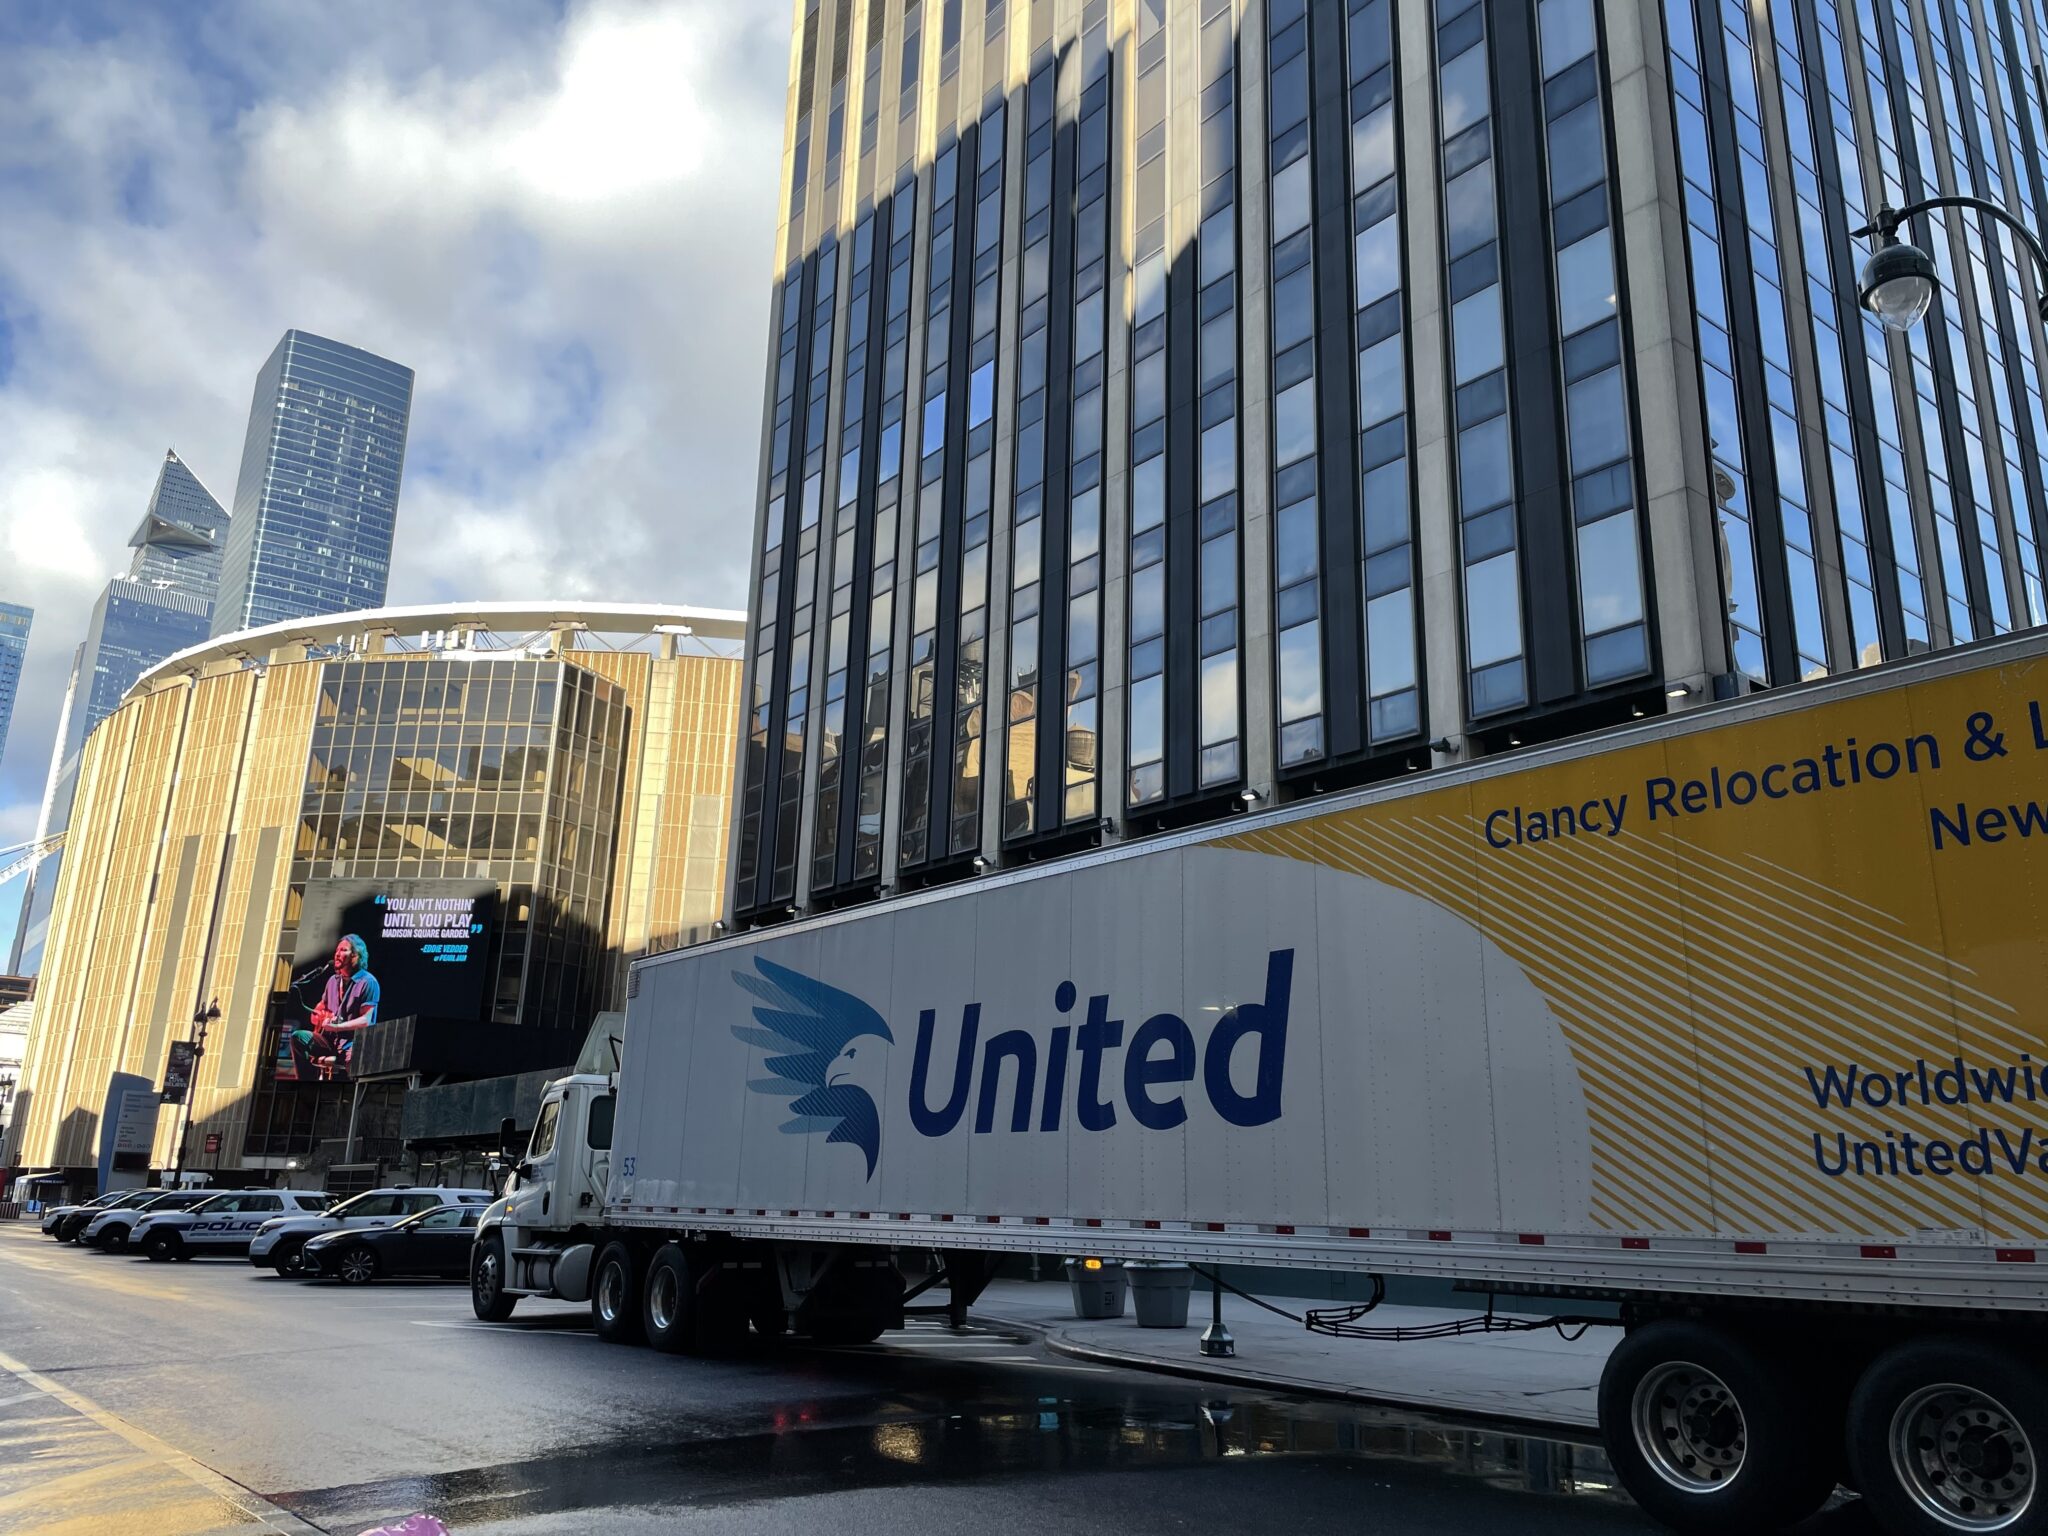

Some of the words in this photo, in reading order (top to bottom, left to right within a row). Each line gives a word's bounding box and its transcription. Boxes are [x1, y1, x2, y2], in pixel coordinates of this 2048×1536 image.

[1485, 794, 1628, 849] Clancy
[1646, 733, 1941, 820] Relocation
[1964, 711, 2009, 761] &
[1930, 801, 2048, 850] New
[408, 898, 434, 911] AIN'T
[434, 898, 475, 911] NOTHIN'
[384, 913, 416, 928] UNTIL
[419, 913, 441, 928] YOU
[382, 929, 413, 939] MADISON
[413, 929, 440, 939] SQUARE
[908, 948, 1295, 1137] United
[623, 1157, 636, 1177] 53
[190, 1222, 263, 1231] POLIC
